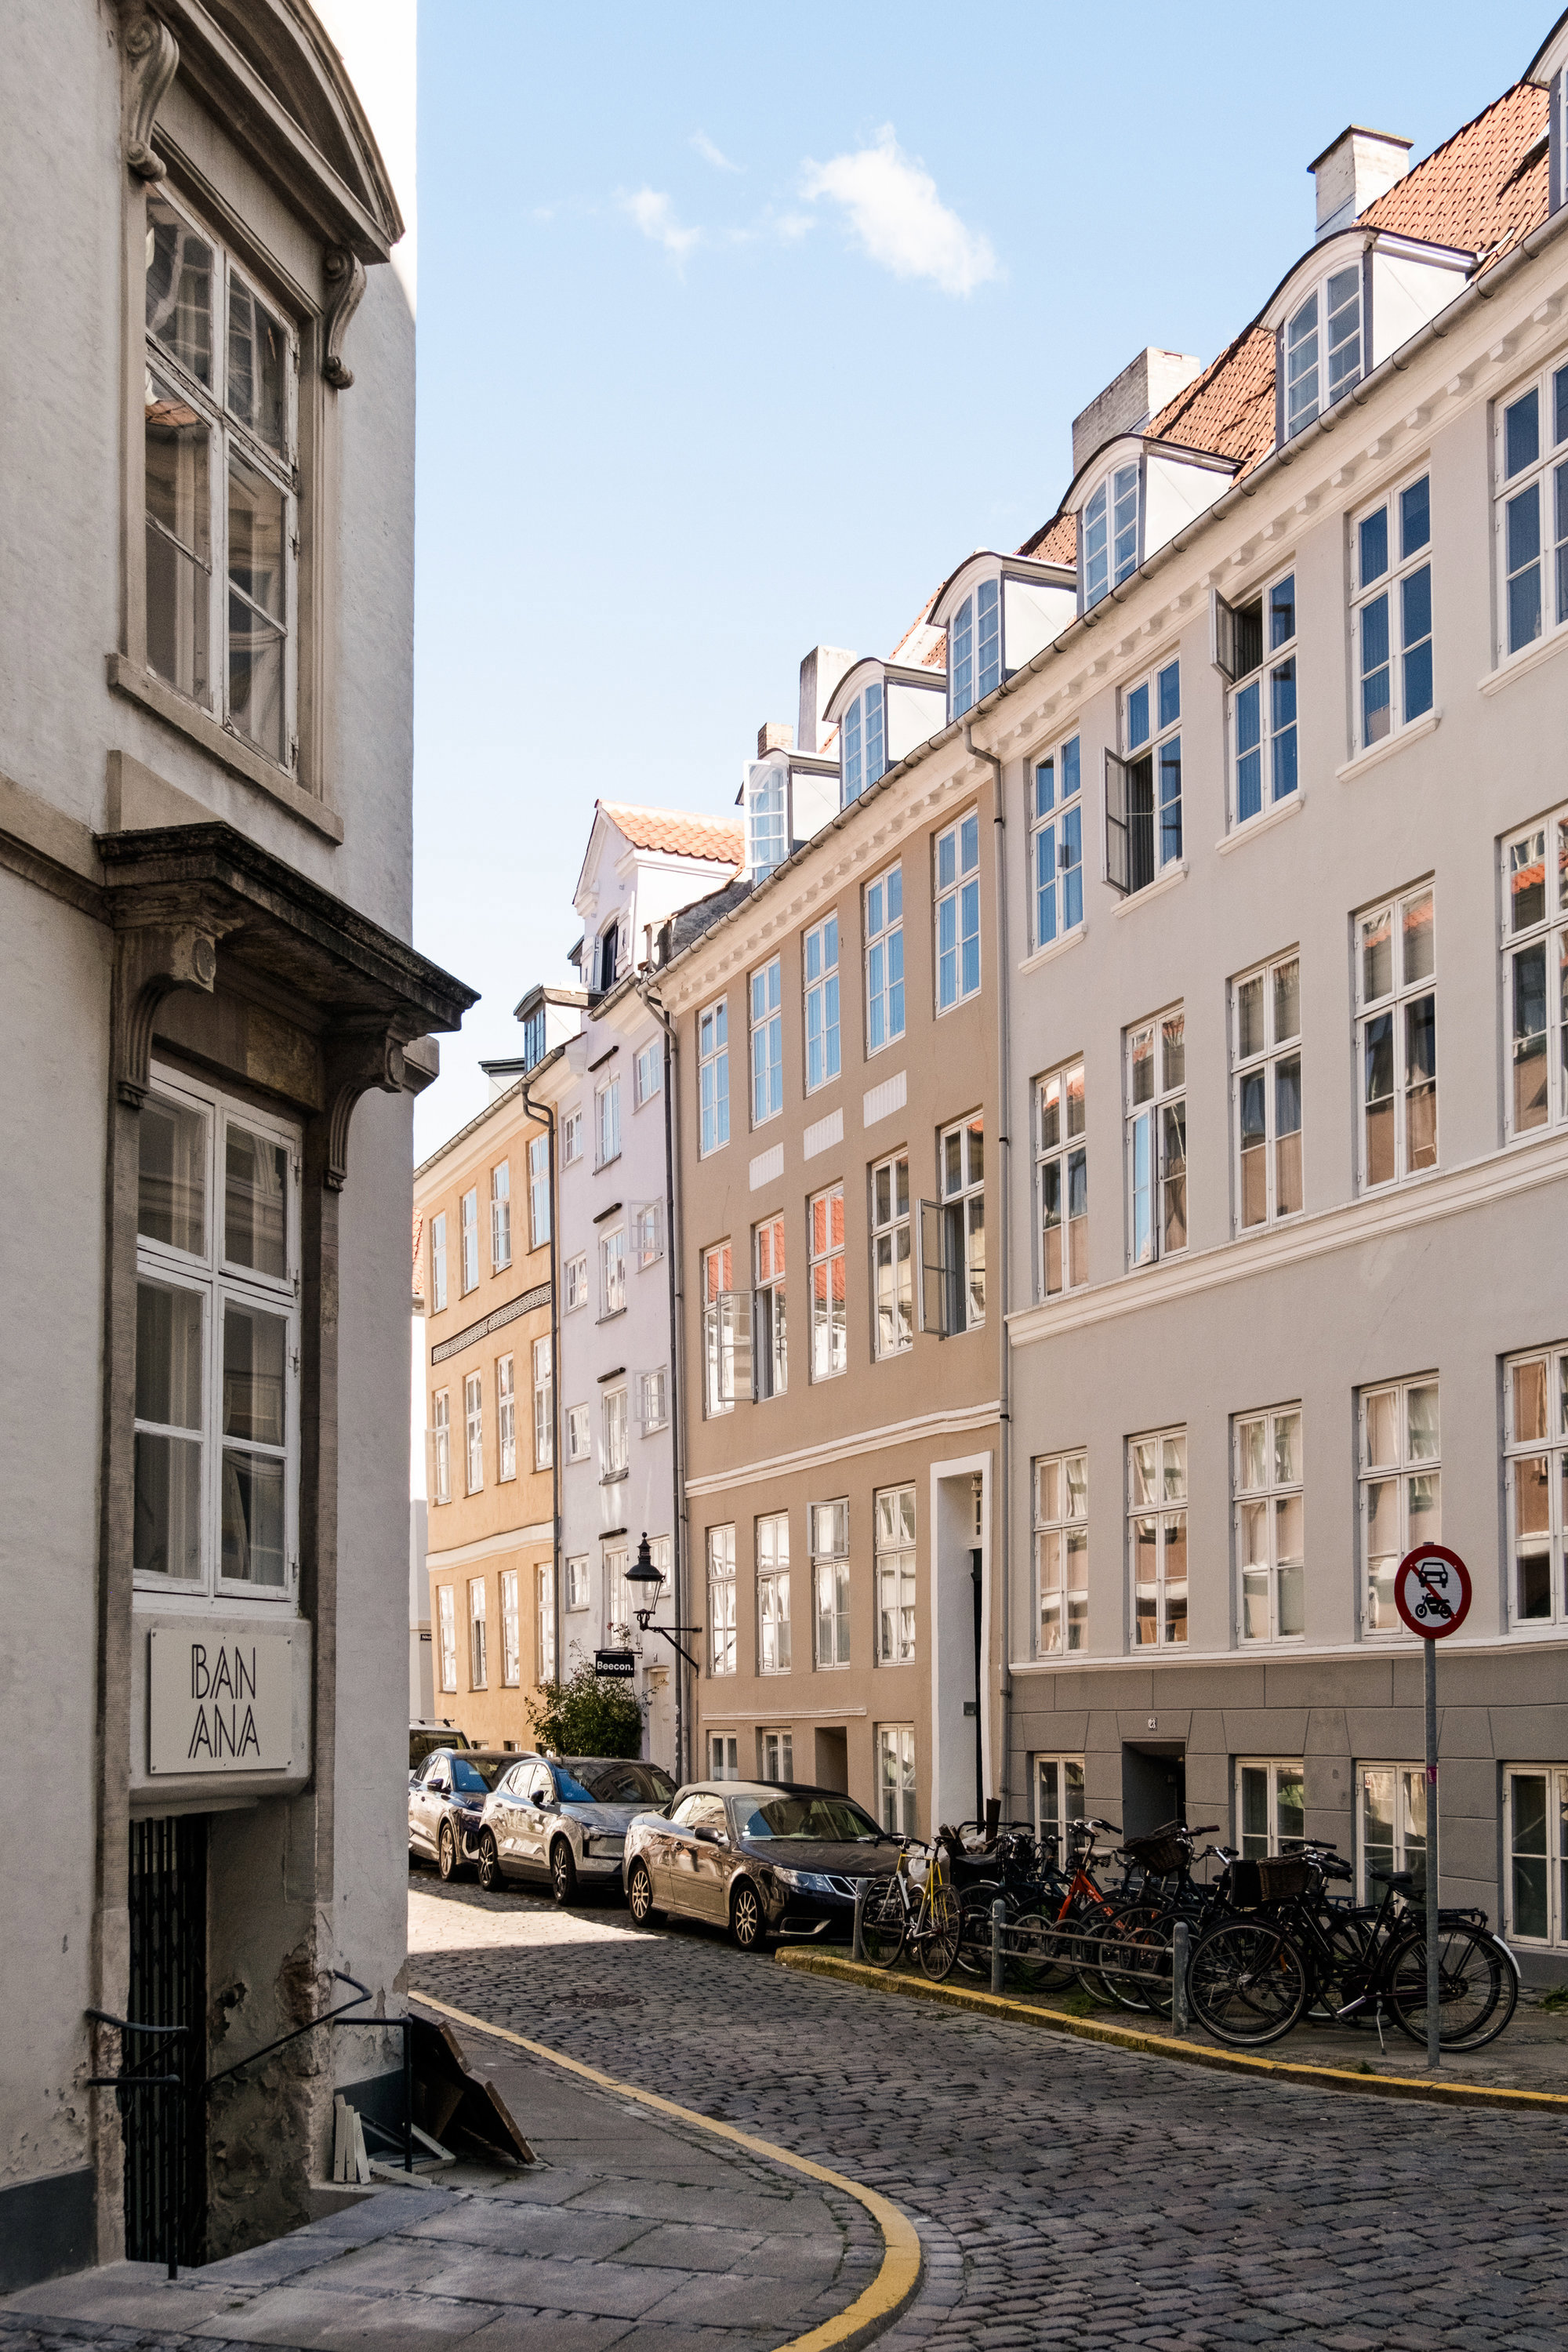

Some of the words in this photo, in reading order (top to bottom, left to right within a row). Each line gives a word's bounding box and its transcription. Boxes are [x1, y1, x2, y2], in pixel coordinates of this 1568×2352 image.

[191, 1643, 256, 1700] BAN
[597, 1661, 633, 1671] Beecon.
[187, 1704, 260, 1759] ANA
